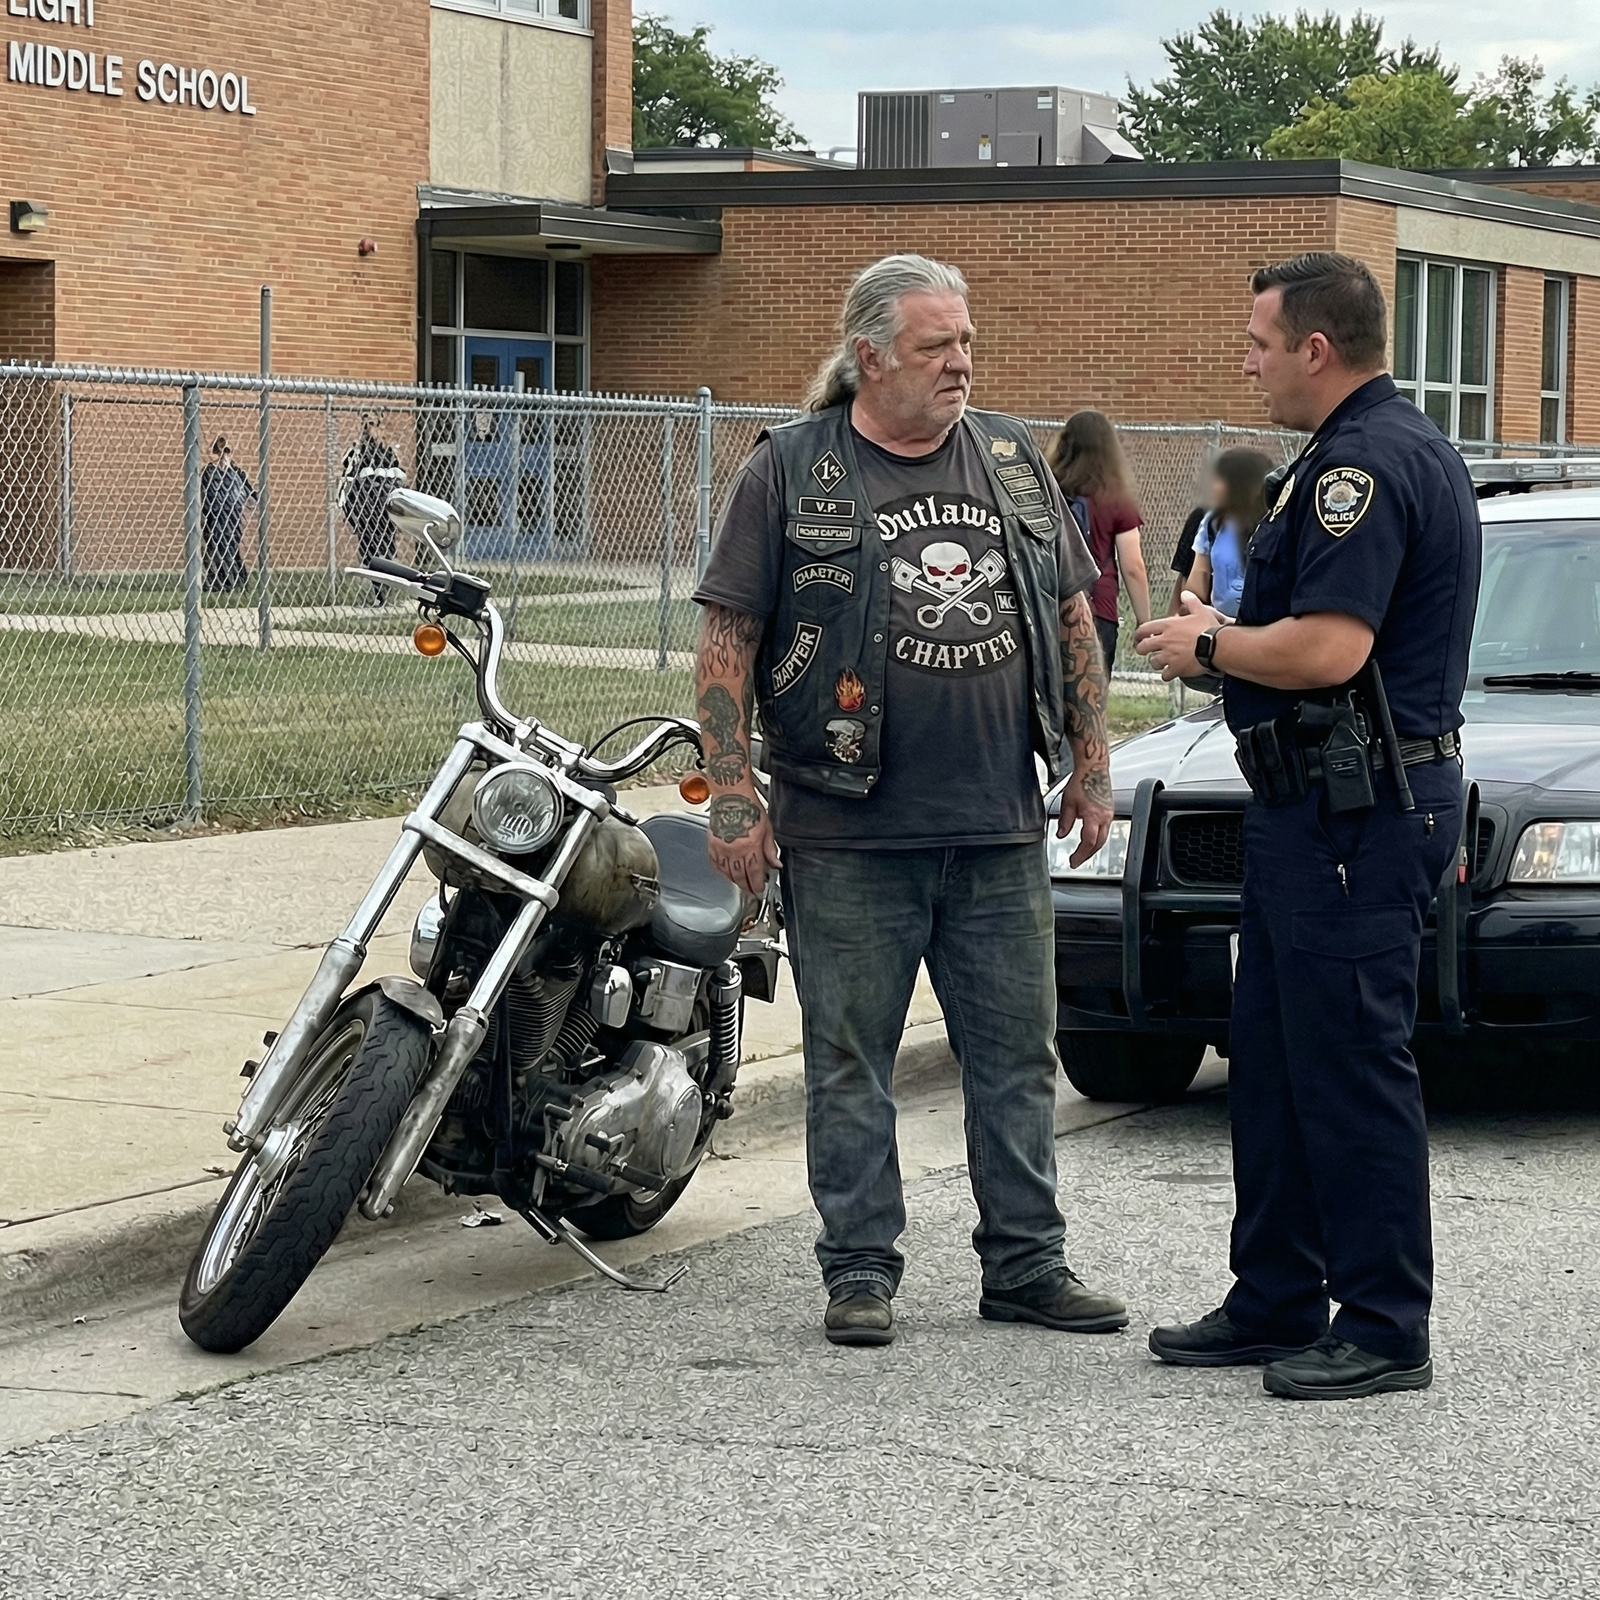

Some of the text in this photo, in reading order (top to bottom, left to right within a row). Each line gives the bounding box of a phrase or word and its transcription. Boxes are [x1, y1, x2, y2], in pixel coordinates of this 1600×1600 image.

[8, 41, 257, 115] MIDDLE SCHOOL
[821, 460, 841, 480] 1%
[815, 502, 837, 513] V.P.
[873, 495, 1001, 541] Outlaws
[1324, 511, 1355, 522] POLICE
[896, 629, 1018, 669] CHAPTER
